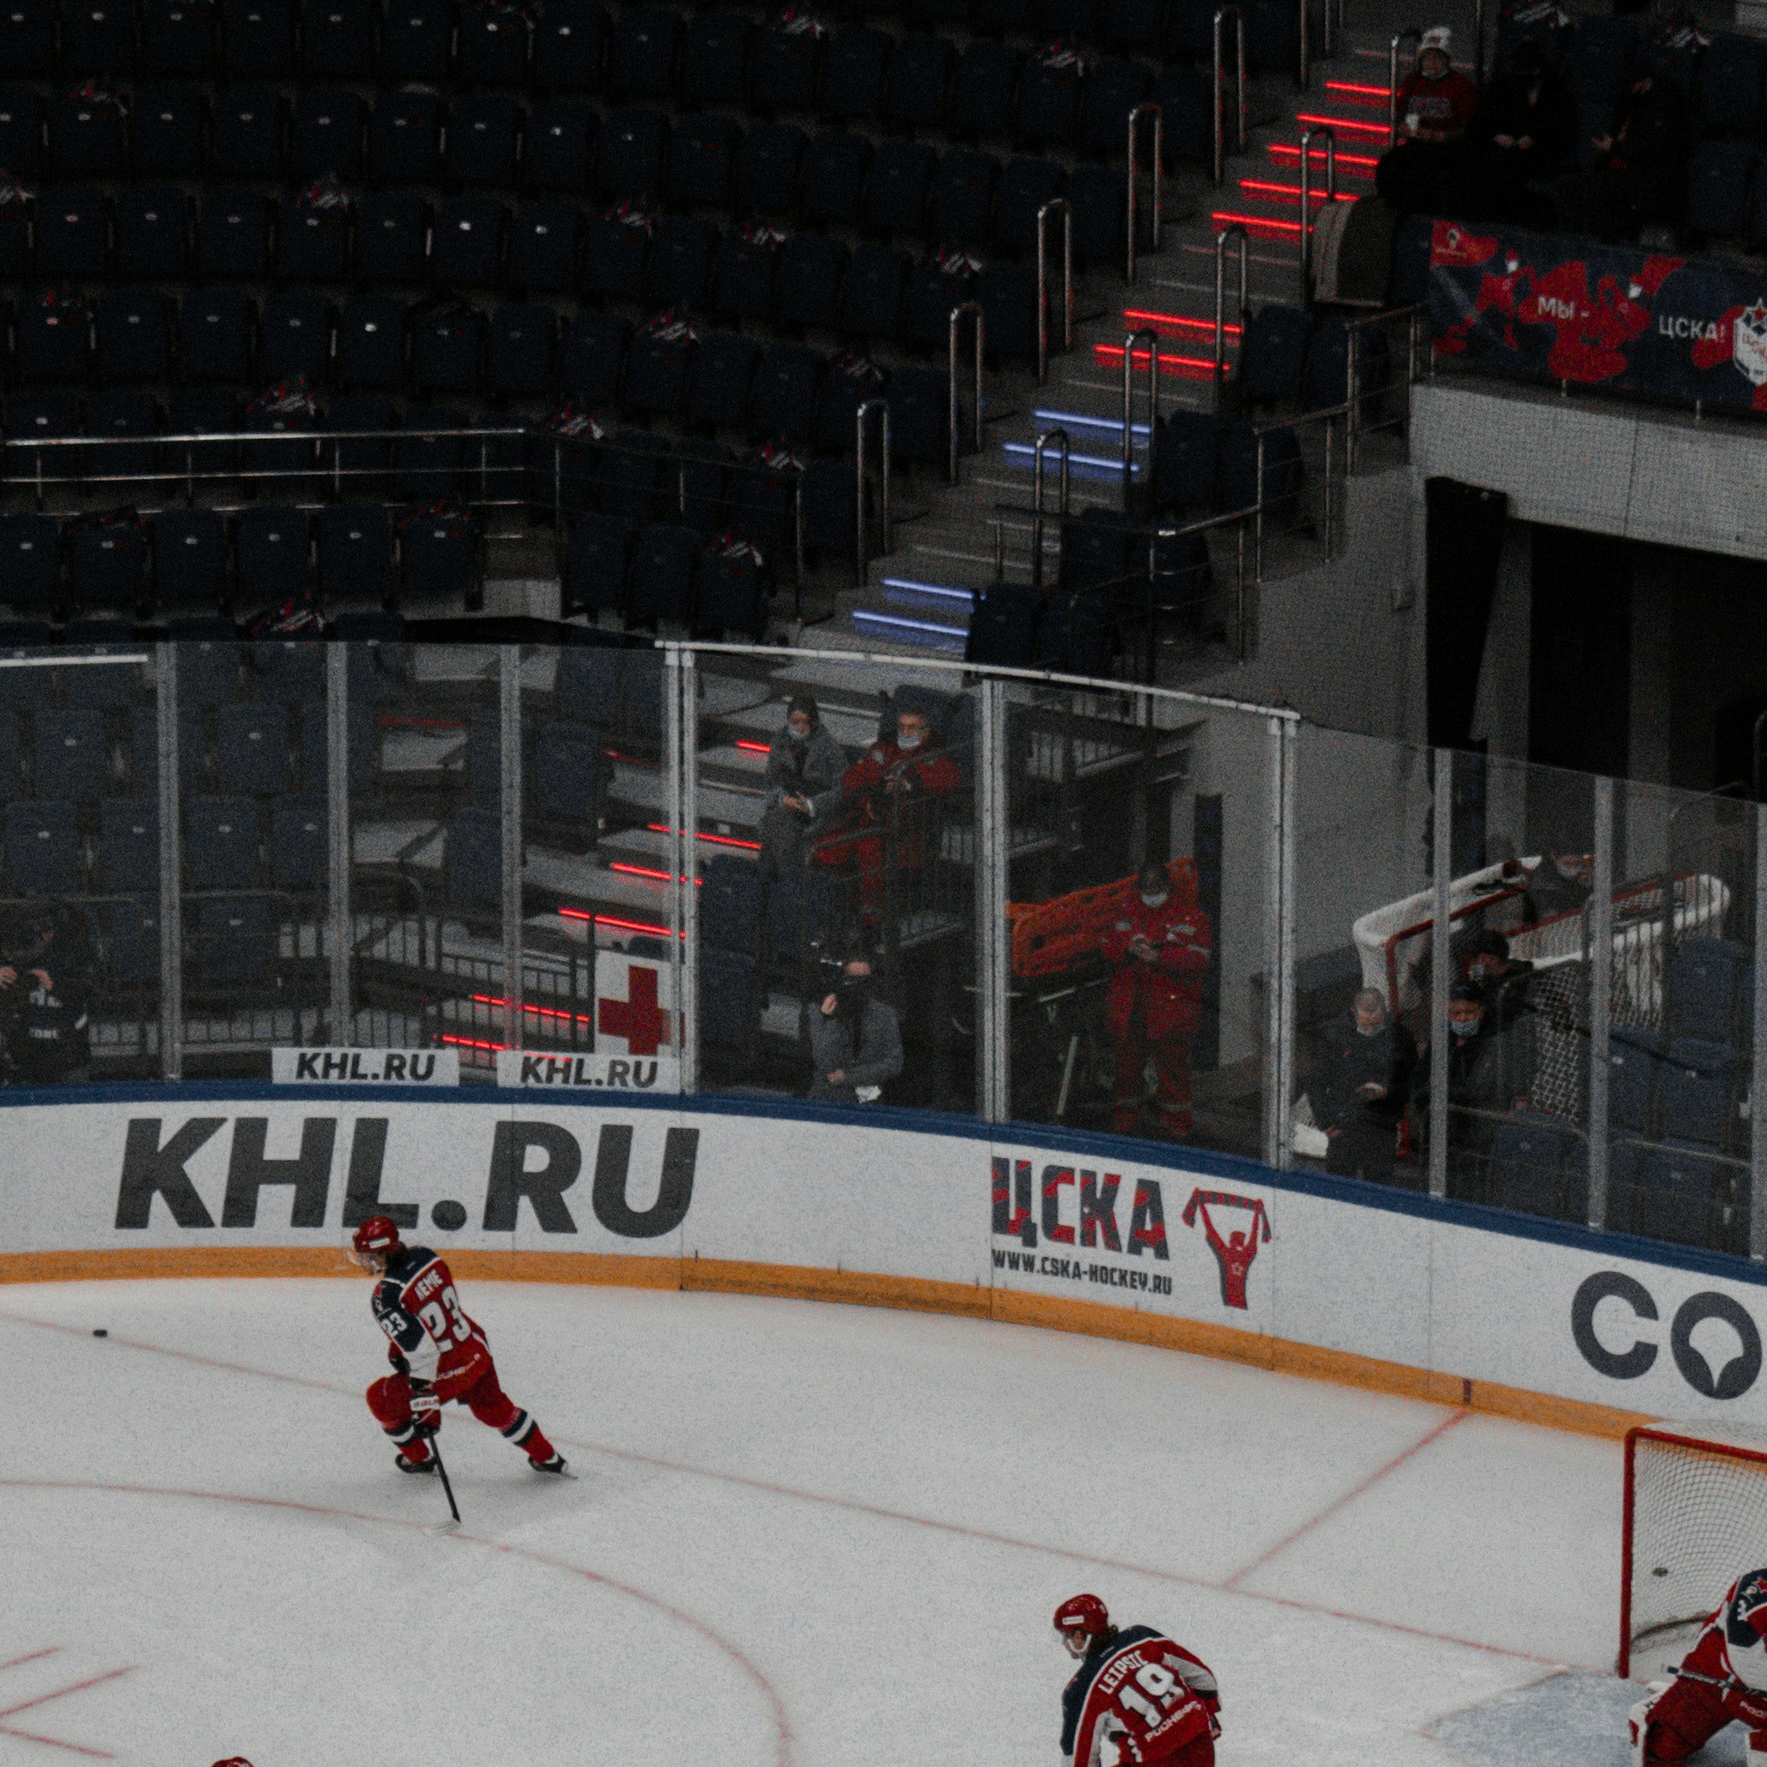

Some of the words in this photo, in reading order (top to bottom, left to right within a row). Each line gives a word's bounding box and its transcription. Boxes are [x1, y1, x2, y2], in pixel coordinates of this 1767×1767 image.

[1537, 295, 1575, 320] МЫ
[1658, 315, 1727, 341] ЦСКА!
[296, 1052, 434, 1081] KHL.RU
[520, 1056, 658, 1088] KHL.RU
[114, 1117, 700, 1238] KHL.RU
[992, 1156, 1170, 1260] ЦСКА
[992, 1249, 1173, 1296] WWW.CSKA-HOCKEY.RU
[417, 1285, 473, 1354] 23
